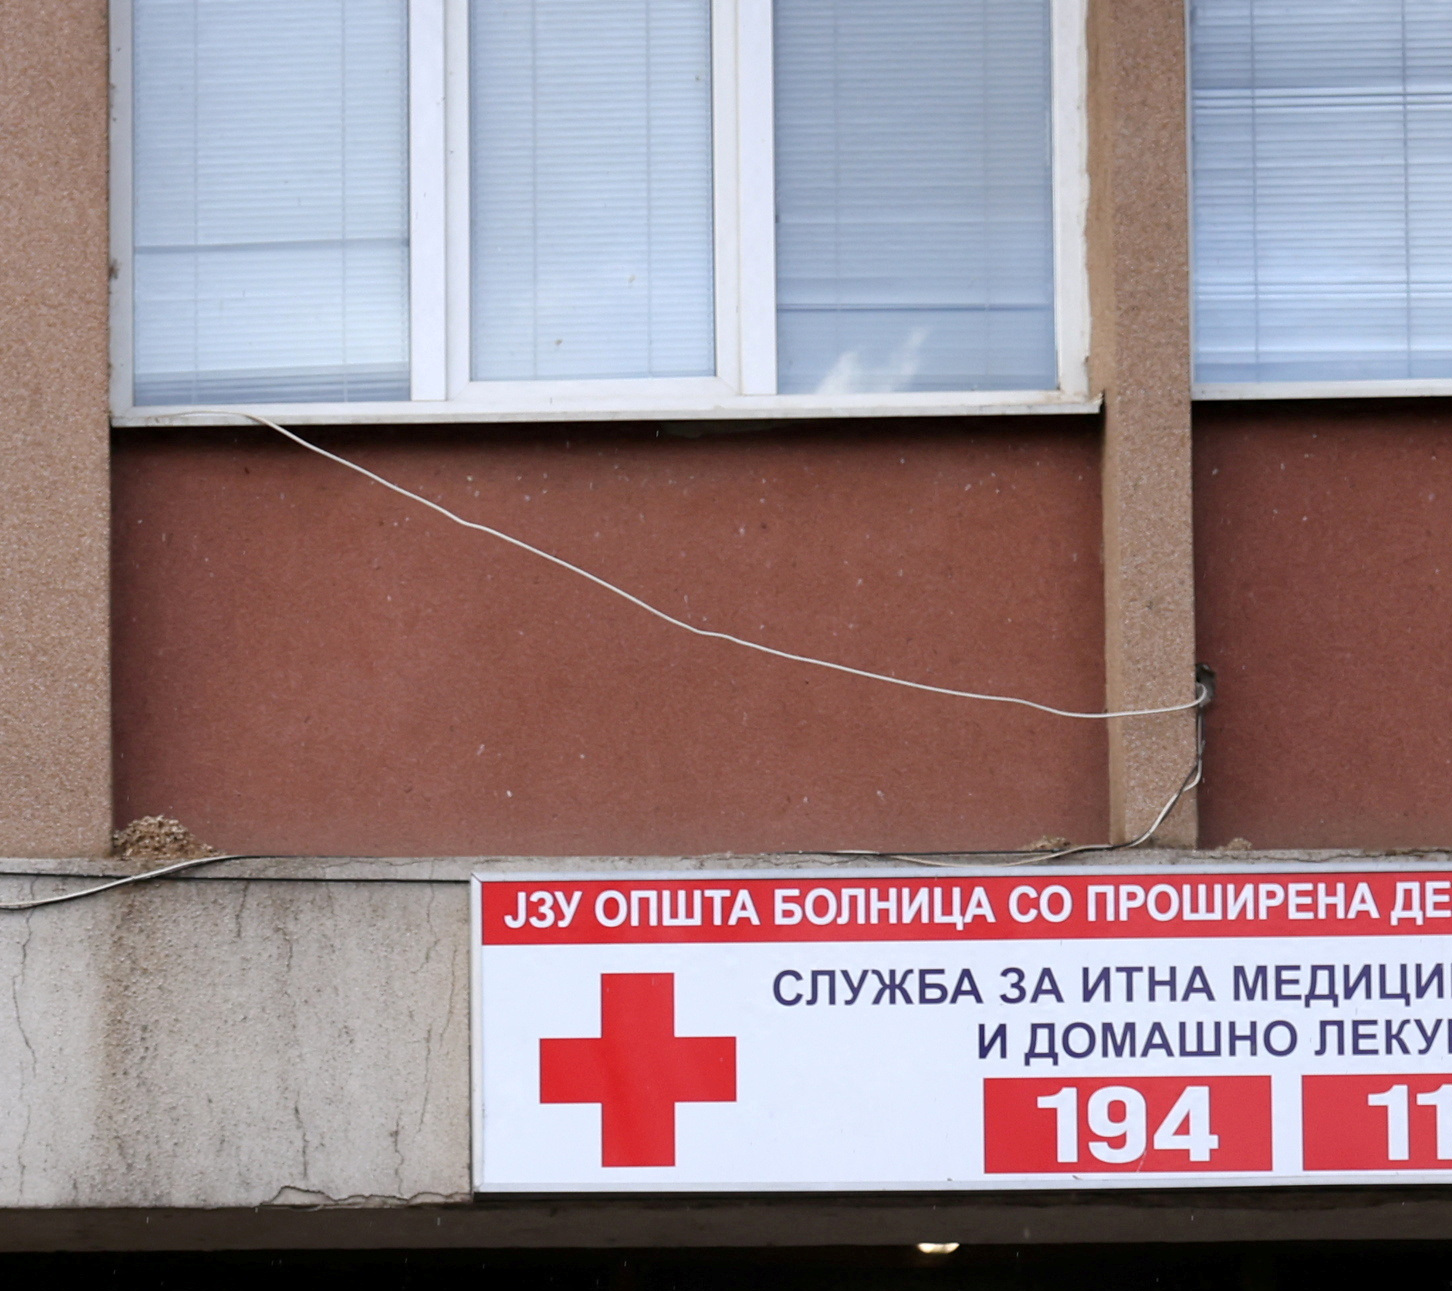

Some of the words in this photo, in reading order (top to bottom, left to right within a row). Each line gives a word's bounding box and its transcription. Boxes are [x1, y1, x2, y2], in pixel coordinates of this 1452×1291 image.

[504, 890, 583, 929] ЈЗУ
[595, 889, 761, 928] ОПШТА
[774, 886, 996, 931] БОЛНИЦА
[1008, 884, 1073, 923] СО
[1087, 882, 1380, 922] ПРОШИРЕНА
[773, 968, 984, 1007] СЛУЖБА
[999, 967, 1064, 1004] ЗА
[1082, 965, 1215, 1003] ИТНА
[978, 1023, 1007, 1059] И
[1024, 1020, 1298, 1067] ДОМАШНО
[1037, 1085, 1219, 1164] 194
